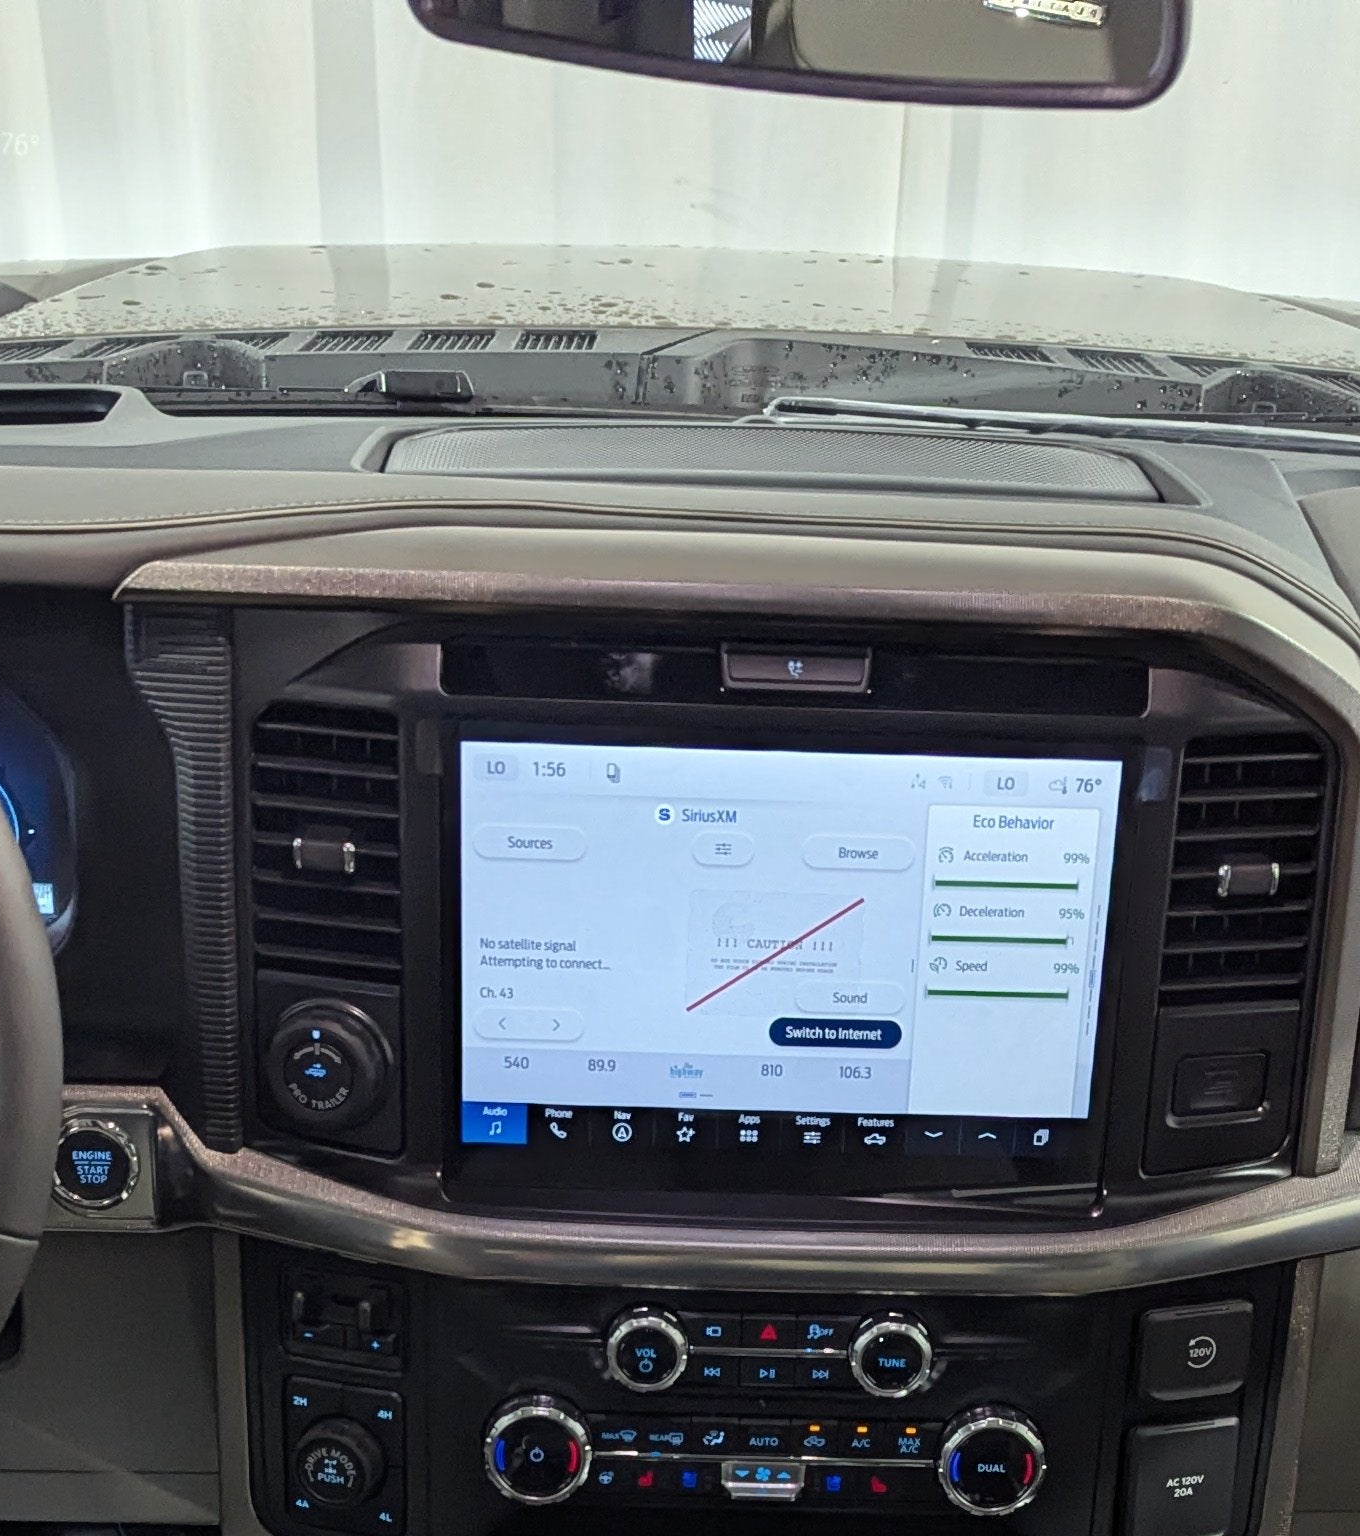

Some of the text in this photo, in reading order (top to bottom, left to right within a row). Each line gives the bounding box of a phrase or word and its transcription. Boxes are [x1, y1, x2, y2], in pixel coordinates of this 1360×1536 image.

[487, 760, 506, 775] LO
[533, 761, 566, 778] 1:56
[997, 777, 1016, 791] LO
[681, 809, 737, 824] SiriusXM
[973, 814, 1055, 830] Eco Behavior
[507, 836, 553, 850] Sources
[838, 847, 879, 860] Browse
[964, 850, 1090, 864] Acceleration 99%
[959, 905, 1085, 920] Deceleration 95%
[480, 938, 576, 954] No satellite signal
[480, 955, 543, 970] Attempting
[546, 958, 557, 968] to
[956, 960, 1080, 974] Speed 99%
[480, 987, 514, 999] Ch. 43
[833, 992, 868, 1004] Sound
[785, 1026, 882, 1040] Switch to Internet
[504, 1057, 529, 1069] 540
[588, 1059, 616, 1072] 89.9
[761, 1064, 783, 1077] 810
[839, 1066, 872, 1079] 106.3
[288, 1083, 349, 1110] PRO TRAILER
[483, 1106, 508, 1117] Audio
[545, 1108, 573, 1119] Phone
[614, 1110, 631, 1120] Nav
[678, 1112, 694, 1122] Fav
[738, 1114, 760, 1125] Apps
[796, 1115, 830, 1127] Settings
[858, 1117, 894, 1128] Features
[72, 1150, 112, 1160] ENGINE
[77, 1166, 109, 1175] START
[80, 1175, 108, 1183] STOP
[819, 1328, 834, 1337] OFF
[635, 1348, 656, 1358] VOL
[1189, 1346, 1212, 1358] 120V
[878, 1357, 907, 1368] TUNE
[292, 1395, 308, 1407] 2H
[377, 1409, 392, 1420] 4H
[749, 1437, 779, 1446] AUTO
[851, 1439, 870, 1448] A/C
[898, 1437, 920, 1446] MAX
[900, 1445, 918, 1454] A/C
[305, 1448, 356, 1476] DRIVE MODE
[977, 1463, 1006, 1473] DUAL
[318, 1472, 344, 1484] PUSH
[1166, 1475, 1204, 1488] AC 120V
[1174, 1486, 1193, 1498] 20A
[296, 1499, 310, 1509] 4A
[379, 1512, 392, 1522] 4L
